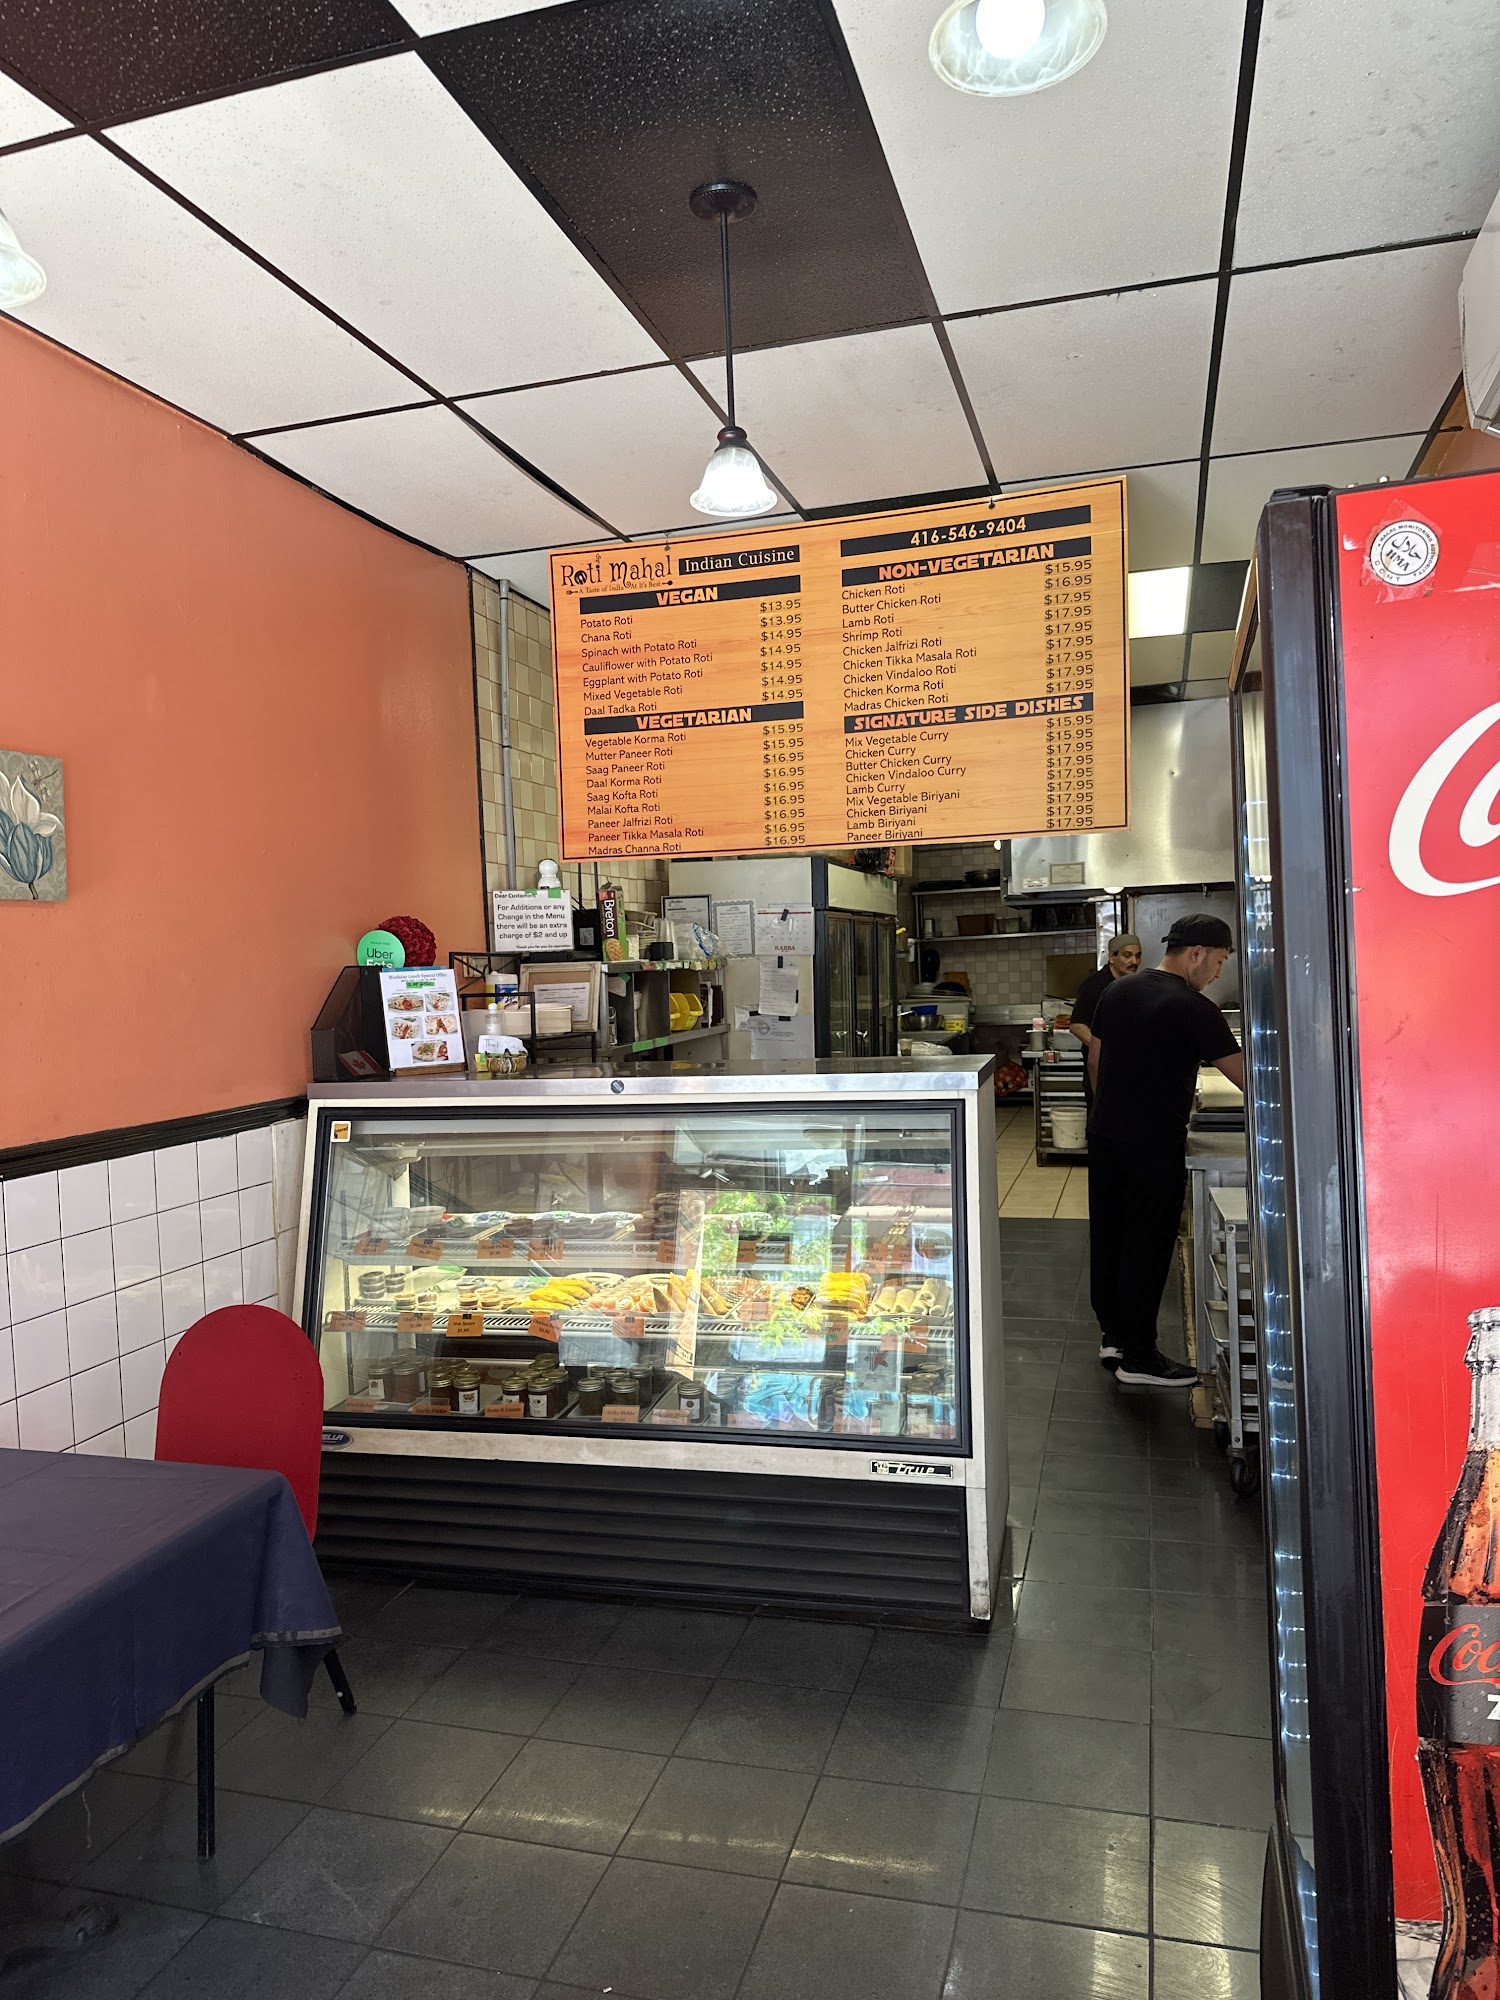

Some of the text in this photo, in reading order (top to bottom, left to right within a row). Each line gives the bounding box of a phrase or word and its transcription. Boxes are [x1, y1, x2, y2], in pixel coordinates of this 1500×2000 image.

[910, 517, 1026, 546] 416-546-9404
[685, 549, 795, 573] Indian Cuisine
[879, 544, 1054, 581] NON-VEGETARIAN
[1380, 525, 1436, 575] HALAL MONITORING AUTHORITY
[1386, 549, 1409, 572] HMA
[561, 555, 673, 588] Roti Mahal
[841, 559, 1092, 600] Chicken Roti $15.95
[656, 586, 718, 606] VEGAN
[842, 591, 1091, 629] Lamb Roti $17.95
[580, 598, 801, 629] Potato Roti $13.95
[842, 604, 1092, 643] Shrimp Roti $17.95
[580, 614, 802, 643] Chana Roti $13.95
[842, 620, 1092, 656] Chicken Jalfrizi Roti $17.95
[581, 628, 802, 660] Spinach with Potato Roti $14.95
[842, 635, 1094, 671] Chicken Tikka Masala Roti $17.95
[583, 674, 803, 702] Mixed Vegetable Roti $14.95
[584, 688, 803, 716] Daal Tadka Roti $14.95
[636, 708, 752, 730] VEGETARIAN
[854, 696, 1083, 731] SIGNATURE SIDE DISHES
[584, 723, 804, 750] Vegetable Korma Roti $15.95
[845, 714, 1093, 749] Mix Vegetable Curry $15.95
[585, 752, 804, 777] Saag Paneer Roti $16.95
[845, 754, 1094, 783] Chicken Vindaloo Curry $17.95
[846, 767, 1094, 795] Lamb Curry $17.95
[846, 780, 1094, 807] Mix Vegetable Biriyani $17.95
[588, 808, 805, 829] Paneer Jalfrizi Roti $16.95
[588, 822, 805, 842] Paneer Tikka Masala Roti $16.95
[847, 816, 1094, 842] Paneer Biriyani $17.95
[588, 834, 806, 856] Madras Channa Roti $16.95
[604, 900, 615, 937] Breton
[500, 932, 523, 940] charge
[367, 948, 393, 959] Uber
